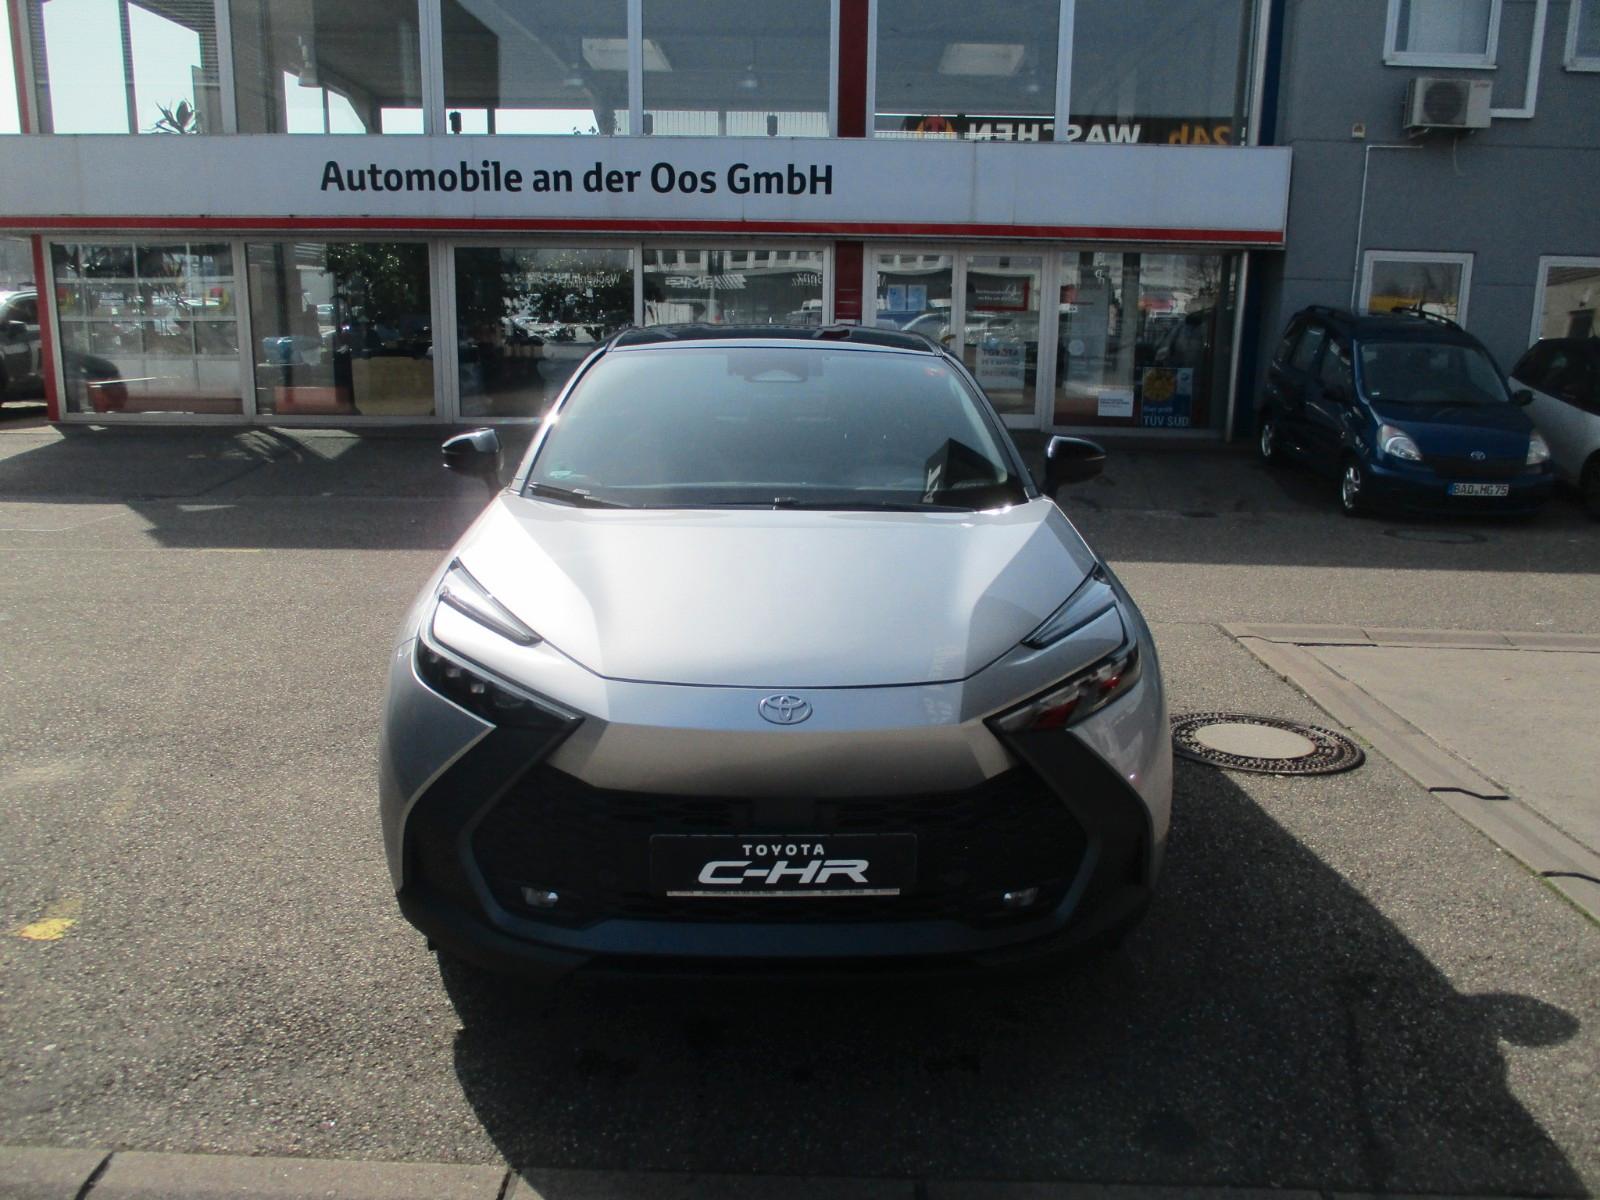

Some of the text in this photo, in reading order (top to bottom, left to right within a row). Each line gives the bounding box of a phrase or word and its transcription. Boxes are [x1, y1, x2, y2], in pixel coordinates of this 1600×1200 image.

[320, 160, 833, 195] Automobile an der Oos GmbH
[742, 843, 825, 856] TOYOTA
[697, 859, 870, 884] C-HR
